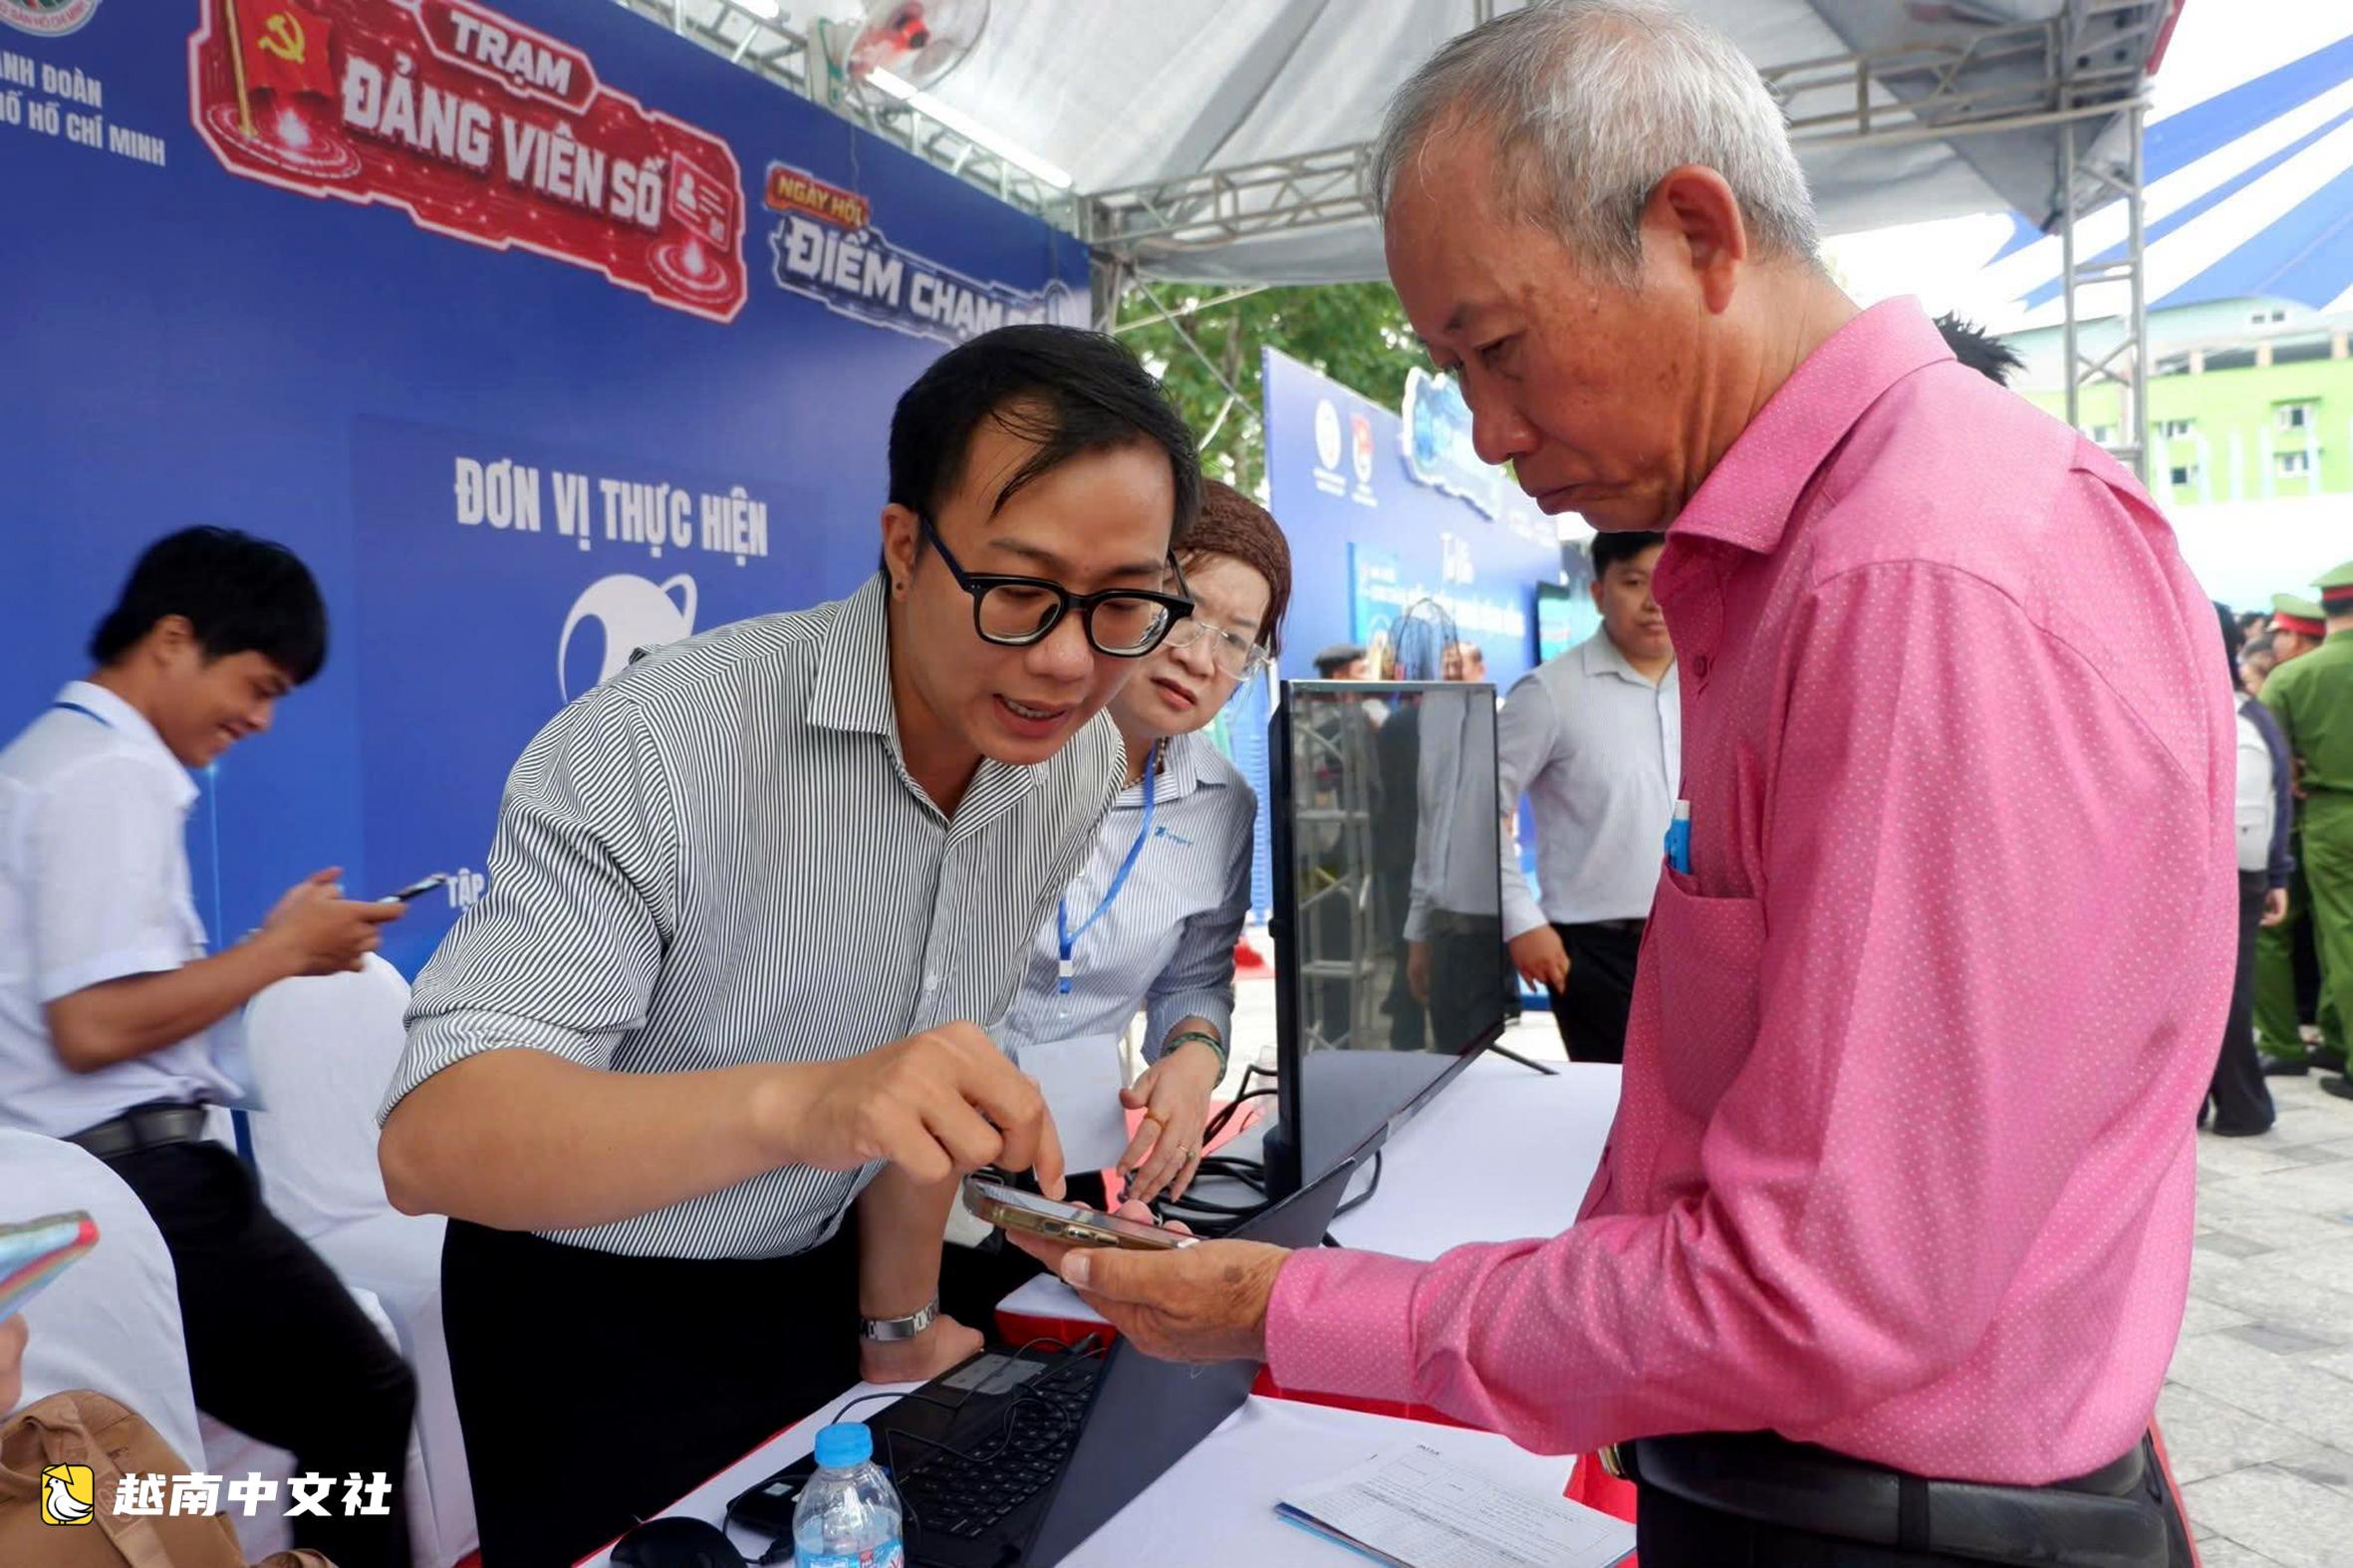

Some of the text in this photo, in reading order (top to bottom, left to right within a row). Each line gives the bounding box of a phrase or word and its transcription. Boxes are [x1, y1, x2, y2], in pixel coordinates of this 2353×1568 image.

[0, 51, 103, 109] NH ĐOÀN
[450, 10, 572, 97] TRẠM
[66, 112, 104, 149] CHÍ
[109, 124, 166, 167] MINH
[342, 52, 667, 227] ĐẢNG VIÊN SỐ
[778, 175, 828, 210] NGÀY
[784, 215, 1002, 339] ĐIỂM CHẠM
[454, 456, 768, 567] ĐƠN VỊ THỰC HIỆN
[446, 868, 485, 913] TẬP
